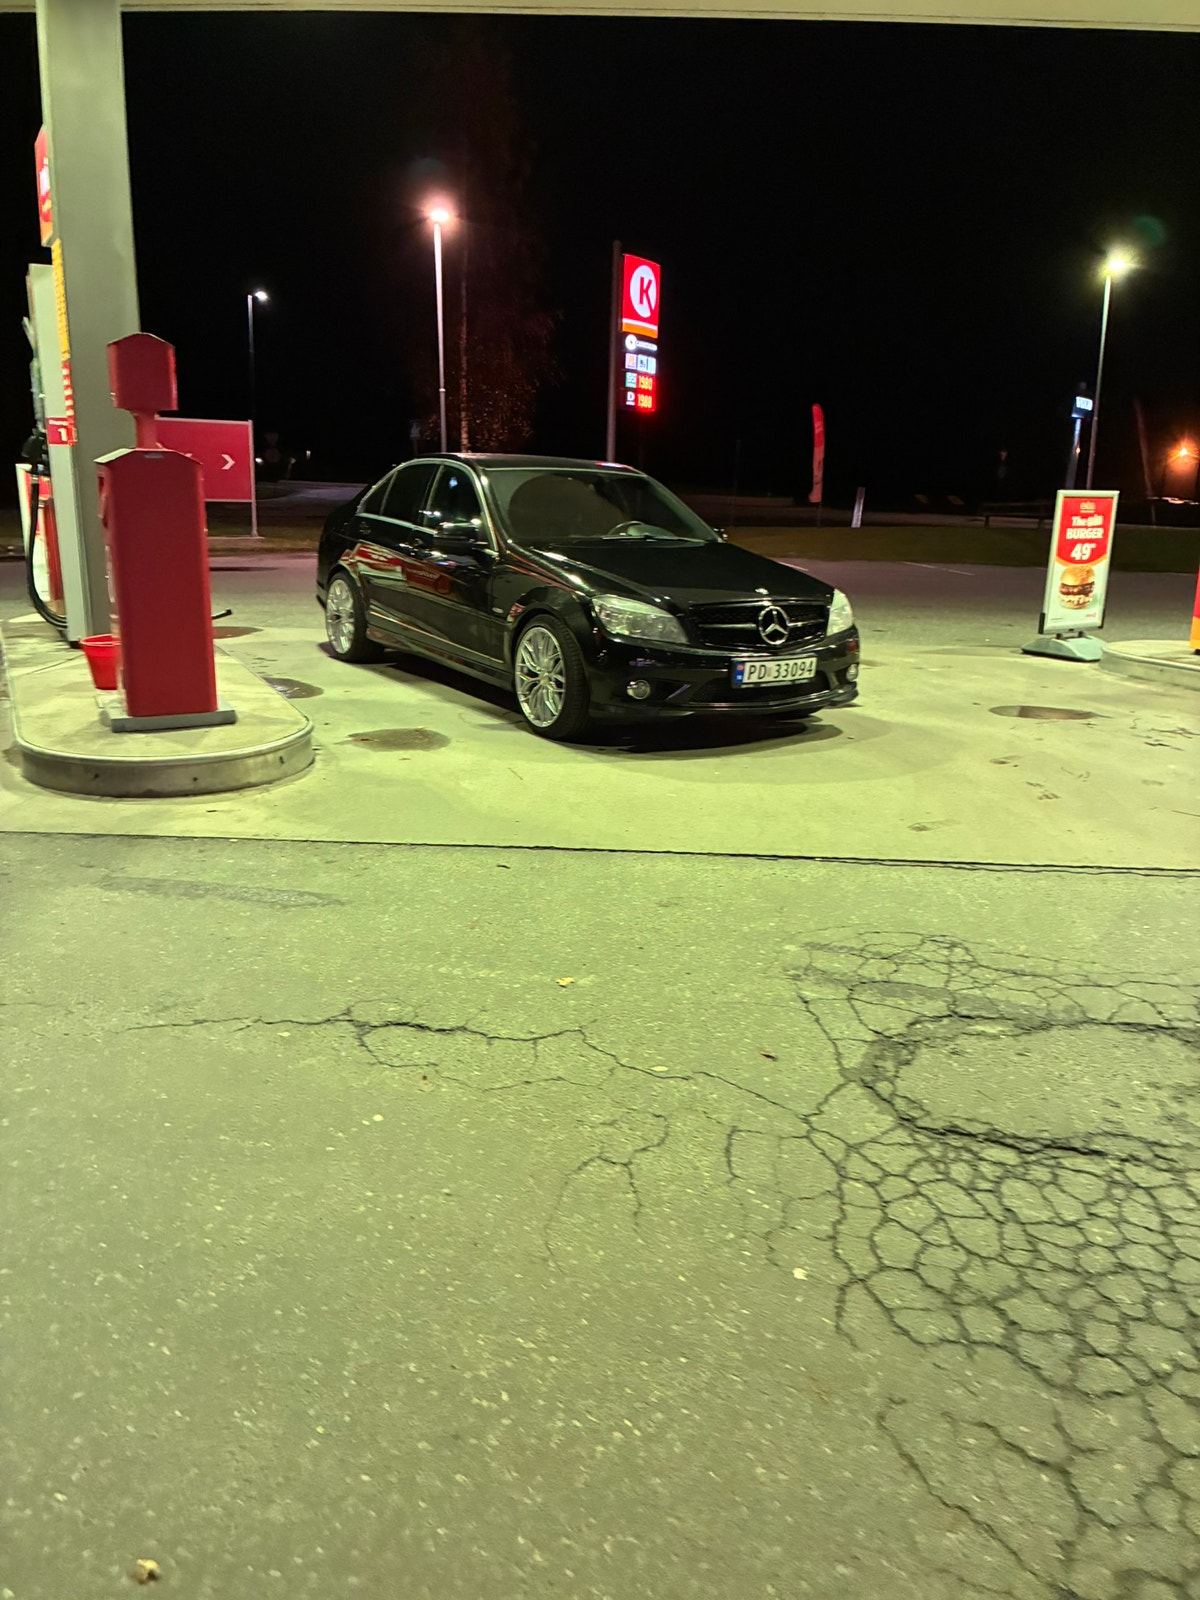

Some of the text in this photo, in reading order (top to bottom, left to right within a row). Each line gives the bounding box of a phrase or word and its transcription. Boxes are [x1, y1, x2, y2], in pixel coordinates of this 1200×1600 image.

[639, 276, 653, 313] K
[627, 391, 635, 401] D
[58, 428, 68, 442] 1
[1072, 516, 1087, 527] The
[1066, 528, 1103, 539] BURGER
[747, 660, 814, 680] PD 33094
